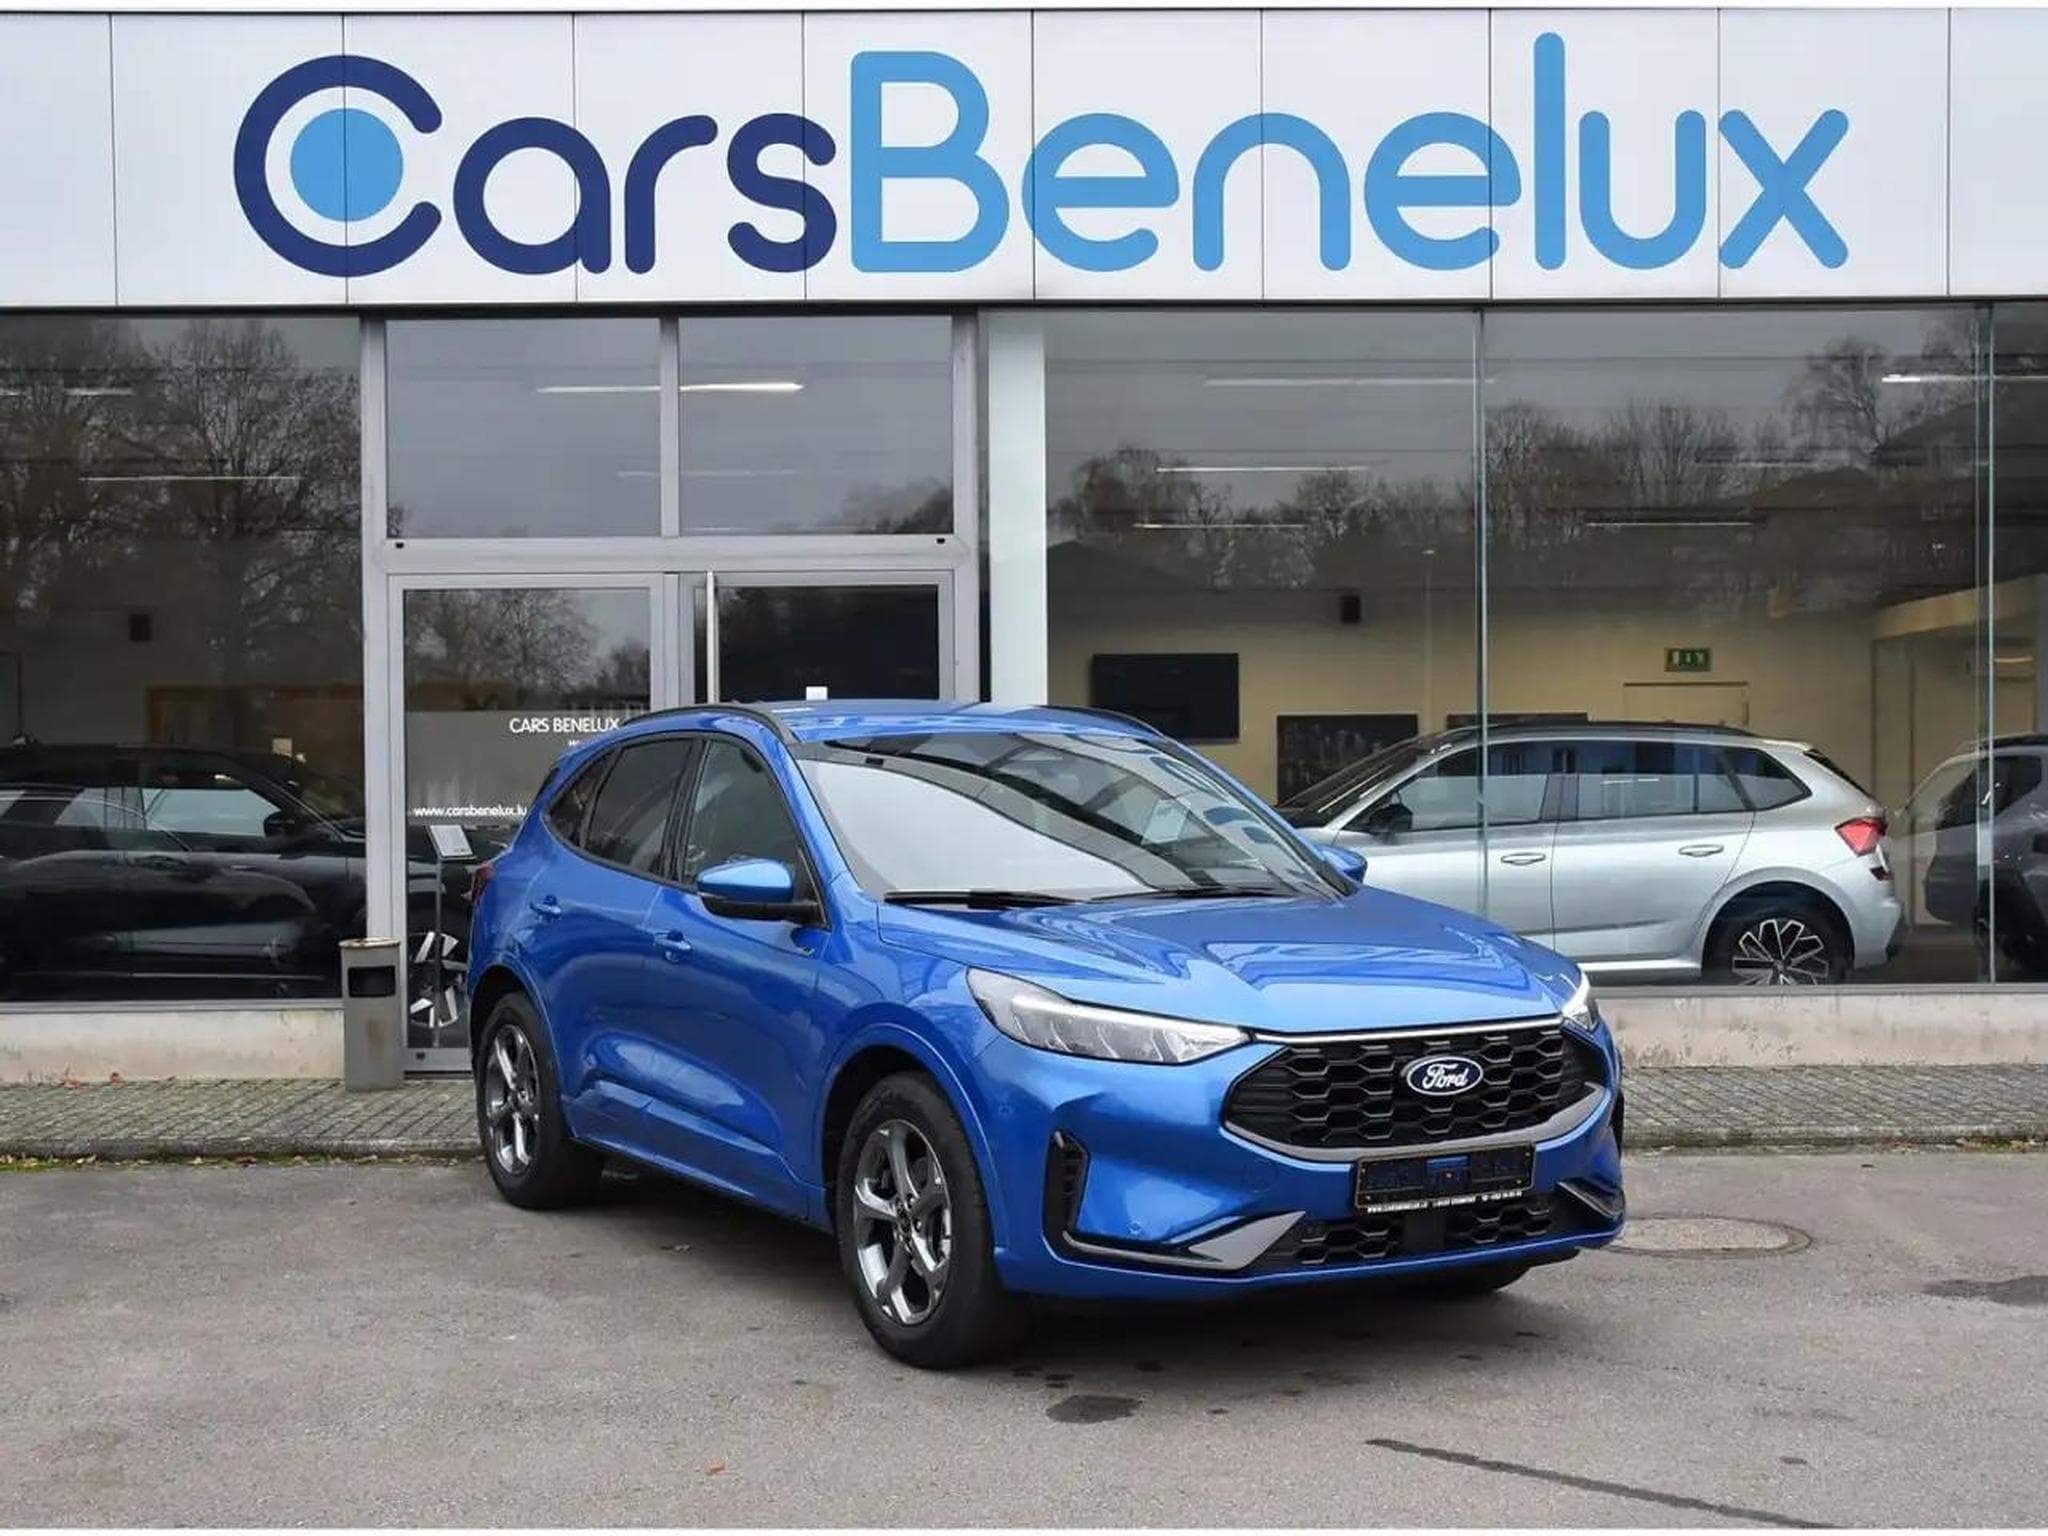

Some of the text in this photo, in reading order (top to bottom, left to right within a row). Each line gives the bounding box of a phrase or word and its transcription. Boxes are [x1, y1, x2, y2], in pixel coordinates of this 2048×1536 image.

[233, 32, 1850, 277] CarsBenelux
[509, 717, 620, 733] CARS BENELUX
[413, 804, 528, 817] www.carsbenelux.lu
[1422, 1063, 1469, 1089] Ford
